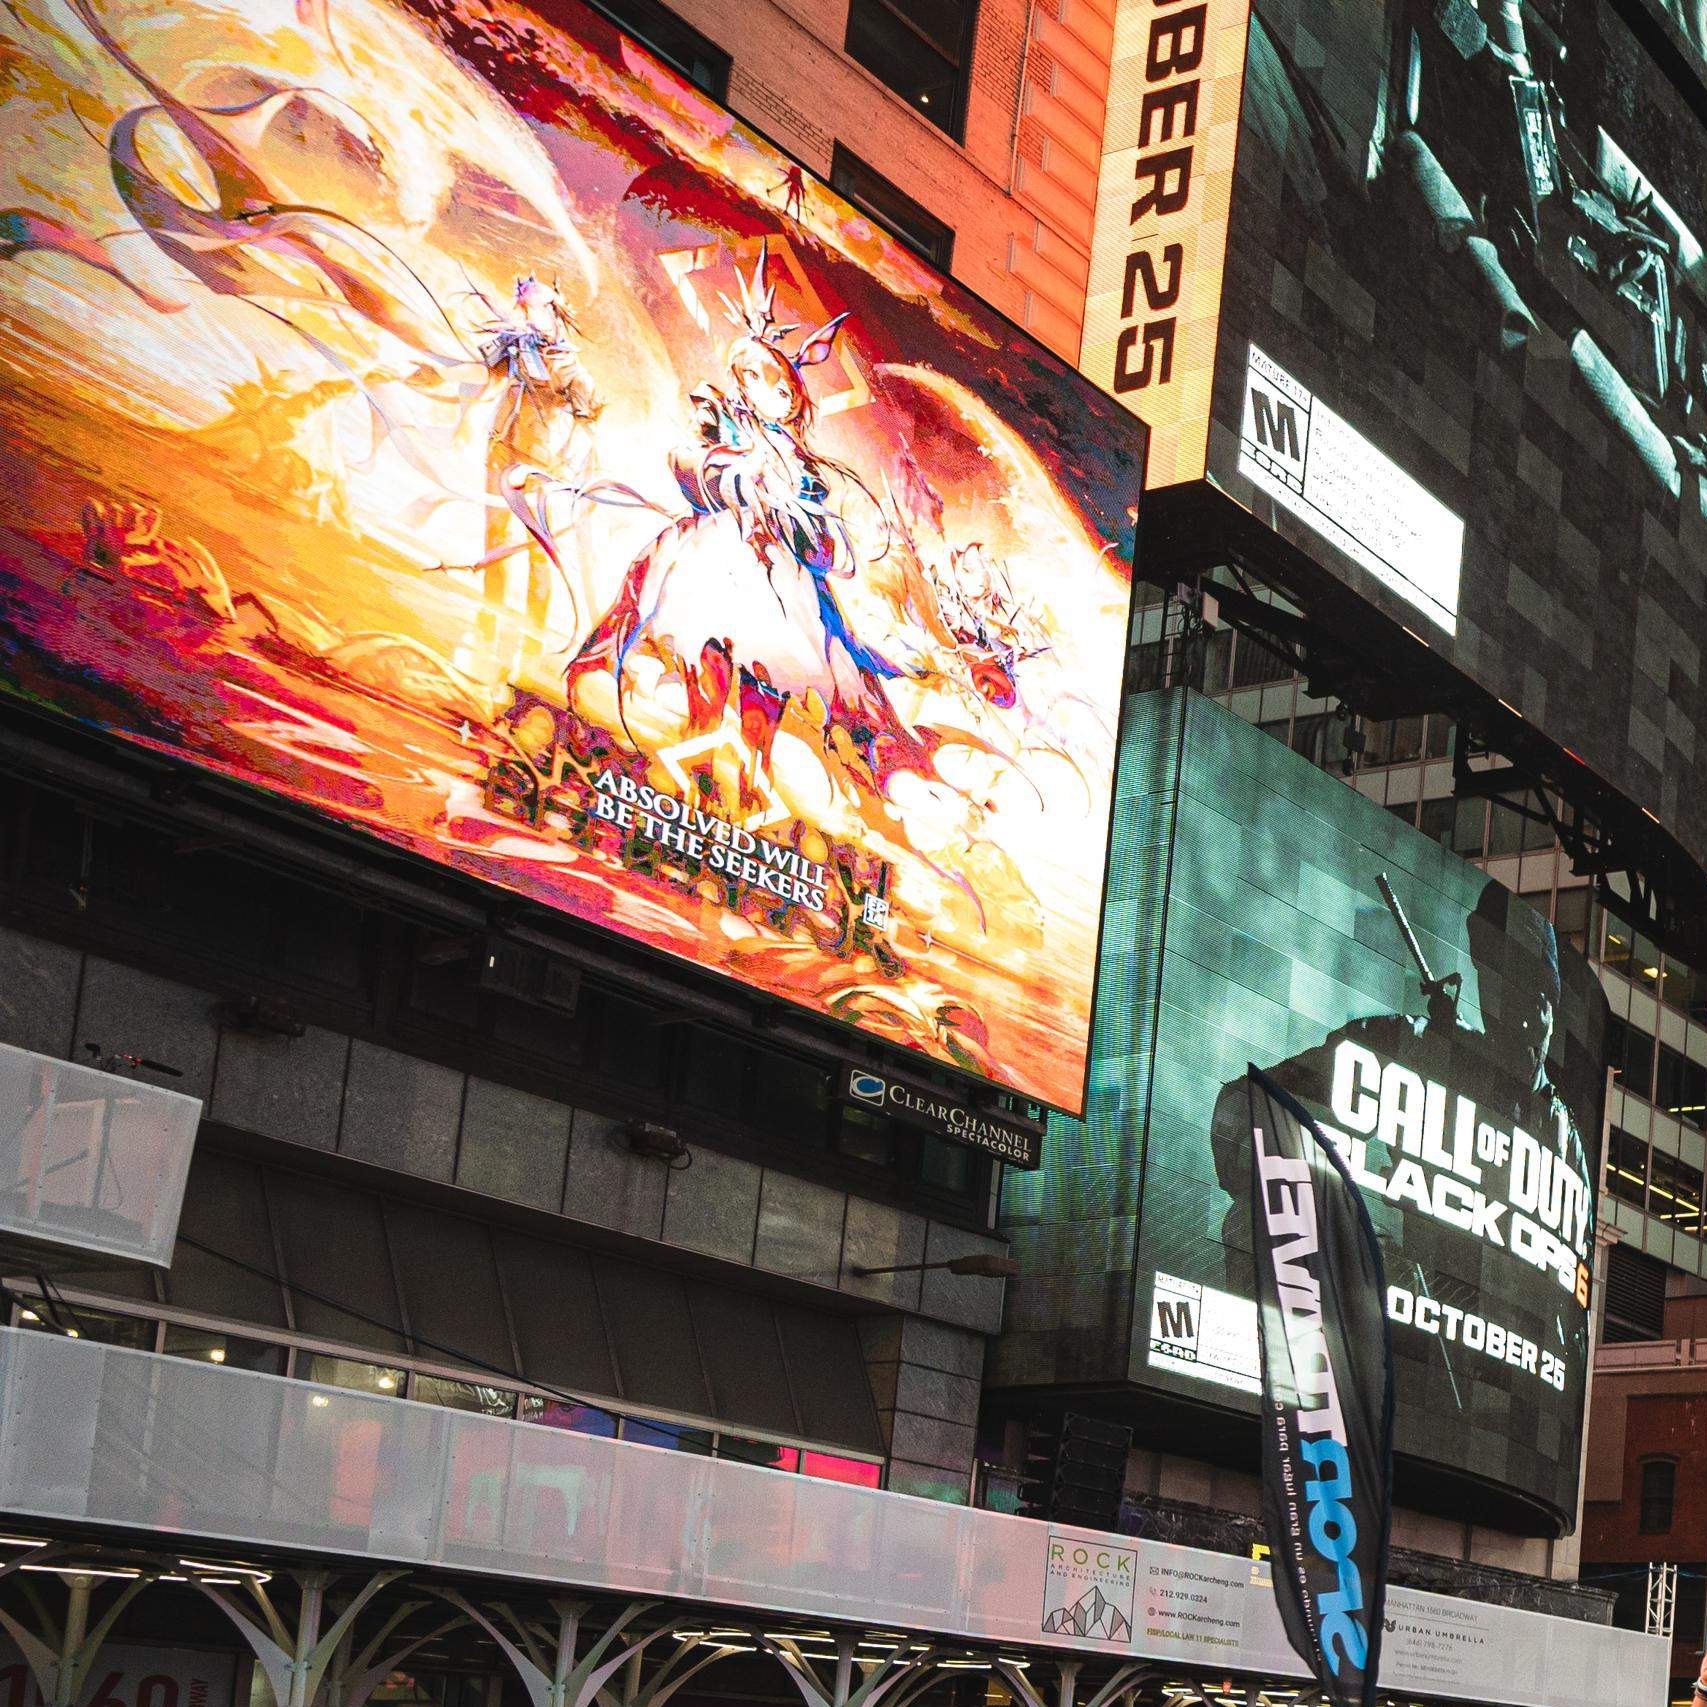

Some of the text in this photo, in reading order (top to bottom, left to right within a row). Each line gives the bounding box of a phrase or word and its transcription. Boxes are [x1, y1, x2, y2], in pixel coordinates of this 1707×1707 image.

[1114, 0, 1208, 394] BER 25
[1251, 387, 1300, 462] M
[595, 769, 829, 890] ABSOLVED WILL
[595, 793, 825, 912] BE THE SEEKERS
[946, 1122, 1030, 1161] SPECTACOLOR
[1332, 1039, 1589, 1252] CALL OF DUTY
[1510, 1211, 1578, 1293] OPS
[1575, 1263, 1589, 1308] 6
[1157, 1301, 1194, 1338] M
[1387, 1286, 1567, 1391] OCTOBER 25
[1050, 1544, 1131, 1574] ROCK
[1051, 1563, 1131, 1581] ARCHITECTURE
[1399, 1625, 1485, 1645] URBAN UMBRELLA
